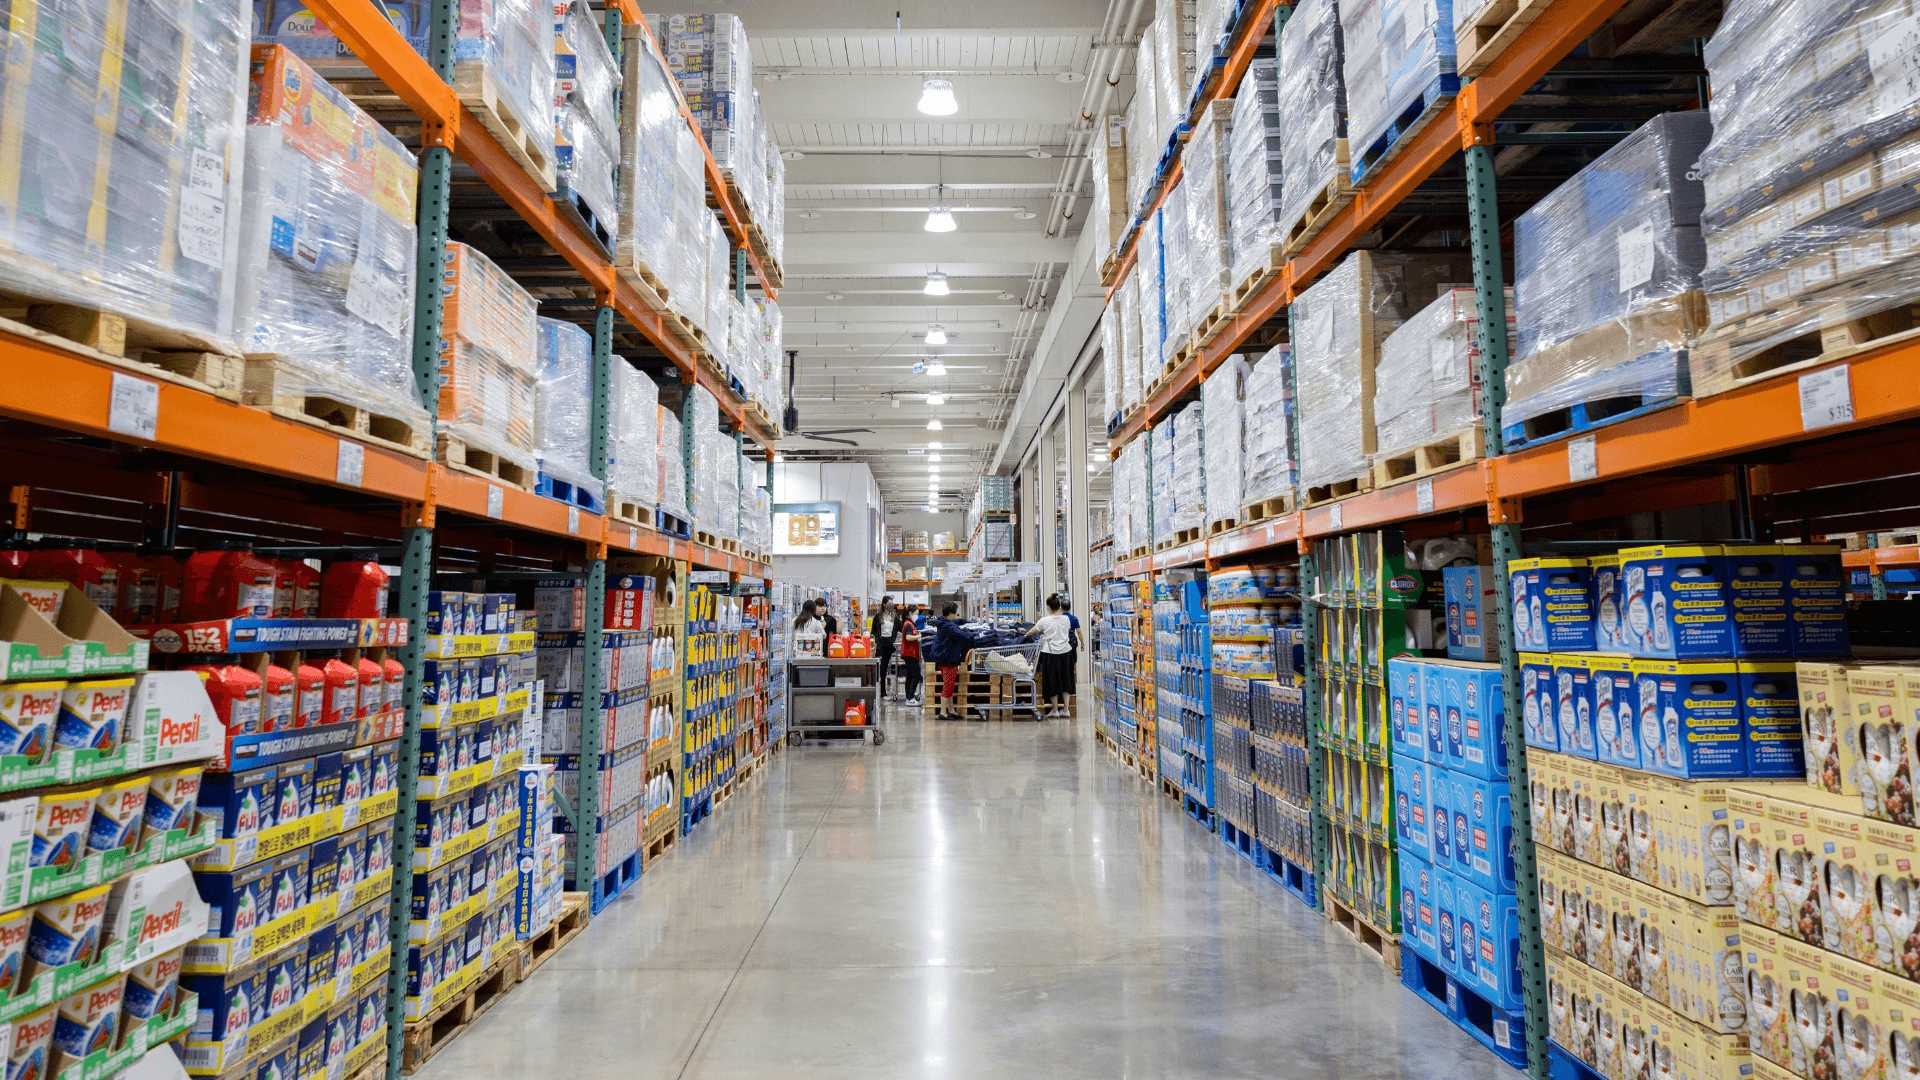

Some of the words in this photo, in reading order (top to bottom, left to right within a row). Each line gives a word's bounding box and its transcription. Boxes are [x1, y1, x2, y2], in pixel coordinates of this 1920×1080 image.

[1390, 580, 1415, 589] CLOROX
[152, 635, 182, 644] ODOR
[184, 627, 221, 644] 152
[257, 627, 280, 643] TOUGH
[280, 627, 300, 642] STAIN
[301, 627, 328, 642] FIGHTING
[328, 626, 349, 641] POWER
[188, 643, 222, 652] PACS
[160, 713, 201, 746] Persil
[258, 739, 282, 757] TOUGH
[281, 736, 300, 754] STAIN
[300, 732, 327, 751] FIGHTING
[327, 729, 349, 747] POWER
[1708, 876, 1730, 885] FLAIR
[139, 901, 183, 944] Persil
[1722, 1004, 1743, 1012] FLAIR
